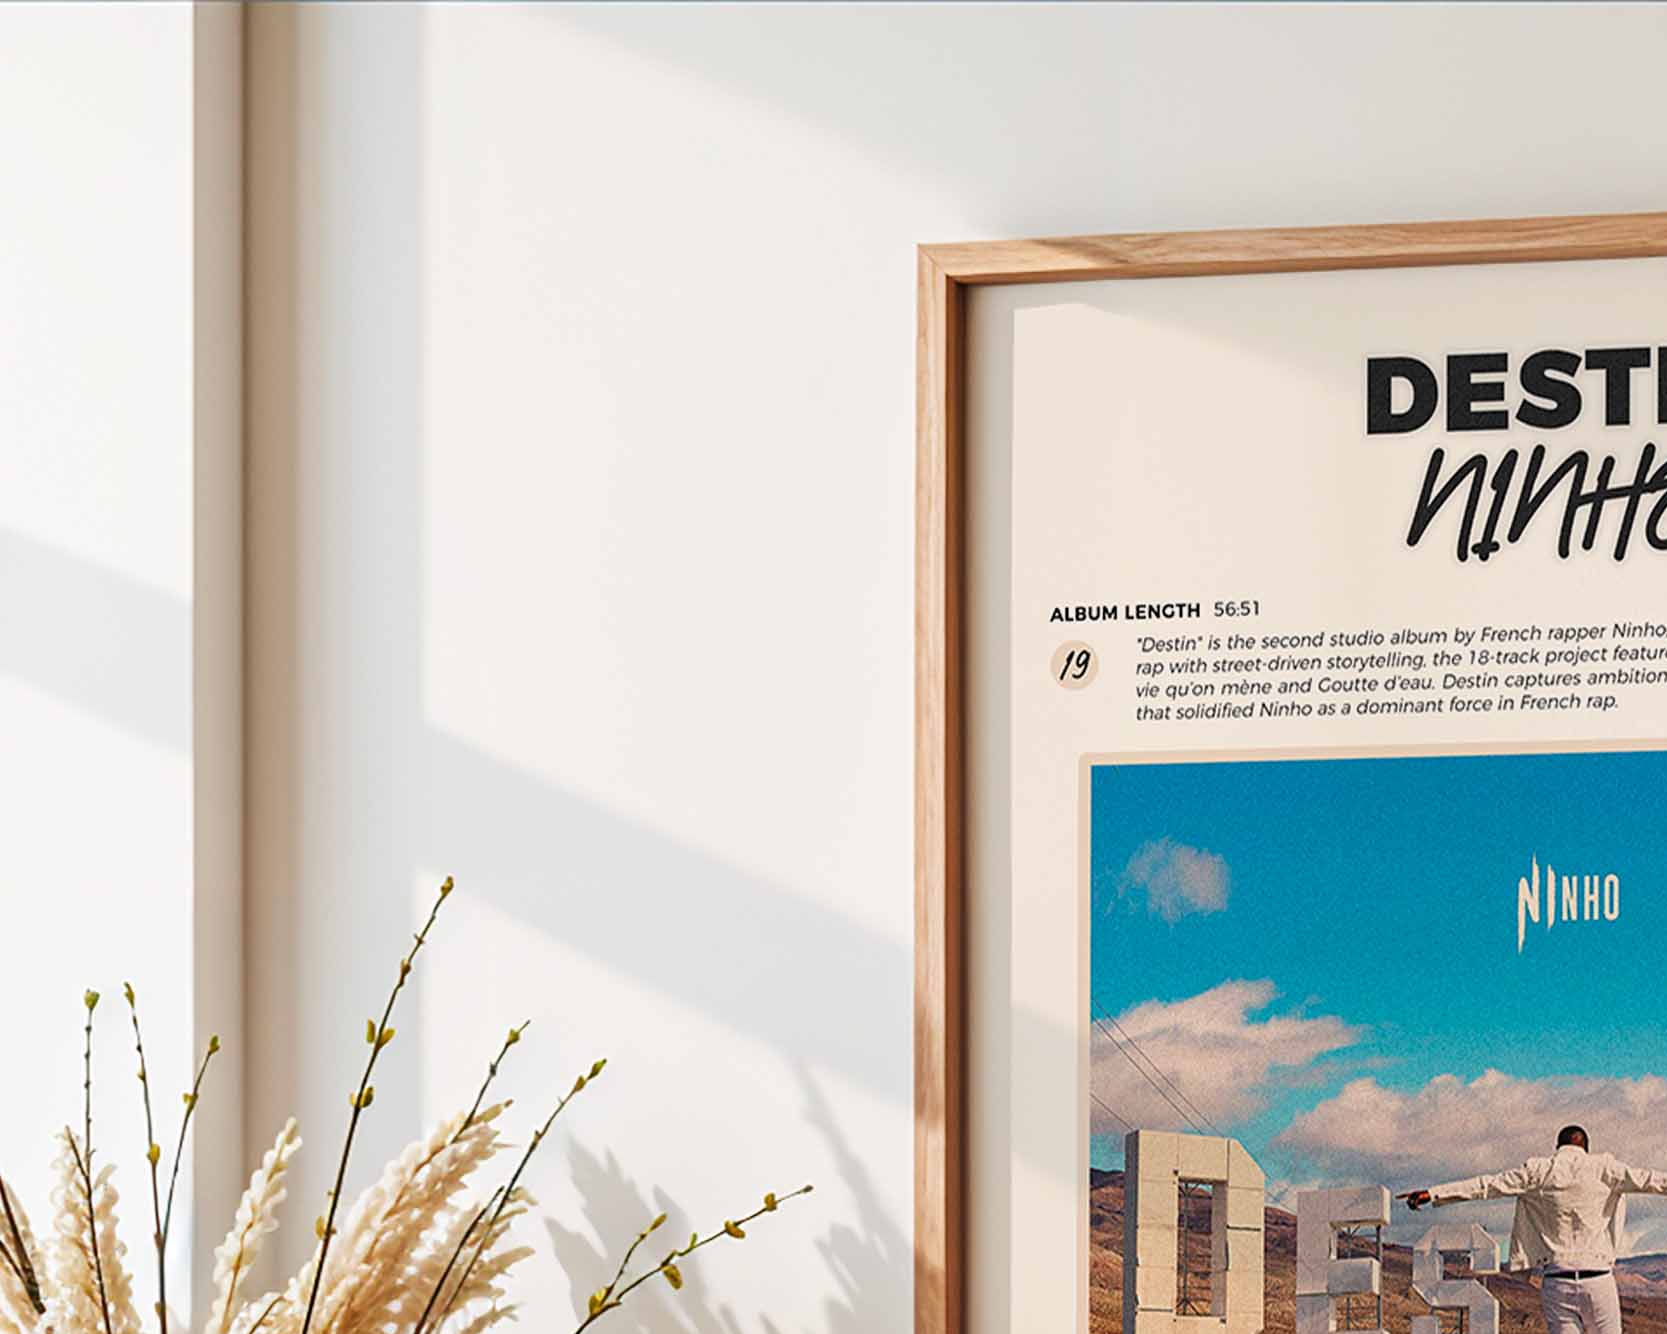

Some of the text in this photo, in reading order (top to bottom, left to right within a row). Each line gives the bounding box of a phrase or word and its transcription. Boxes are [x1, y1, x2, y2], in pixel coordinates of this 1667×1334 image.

[1050, 600, 1259, 622] ALBUM LENGTH 56:51
[1207, 634, 1221, 652] is
[1227, 634, 1257, 650] the
[1260, 632, 1326, 650] second
[1329, 629, 1385, 648] studio
[1390, 628, 1448, 646] album
[1453, 627, 1477, 647] by
[1479, 624, 1542, 643] French
[1546, 626, 1607, 644] rapper
[1060, 650, 1091, 681] 19
[1135, 659, 1165, 678] rap
[1169, 658, 1208, 674] with
[1212, 654, 1322, 674] street-driven
[1432, 650, 1463, 667] the
[1470, 647, 1543, 666] 18-track
[1544, 646, 1608, 667] project
[1136, 682, 1161, 698] vie
[1220, 679, 1273, 696] mène
[1277, 677, 1313, 694] and
[1317, 677, 1380, 694] Goutte
[1442, 671, 1499, 690] Destin
[1504, 672, 1582, 690] captures
[1136, 694, 1618, 721] that solidified Ninho as a dominant force in French rap.
[1517, 851, 1620, 954] NINHO
